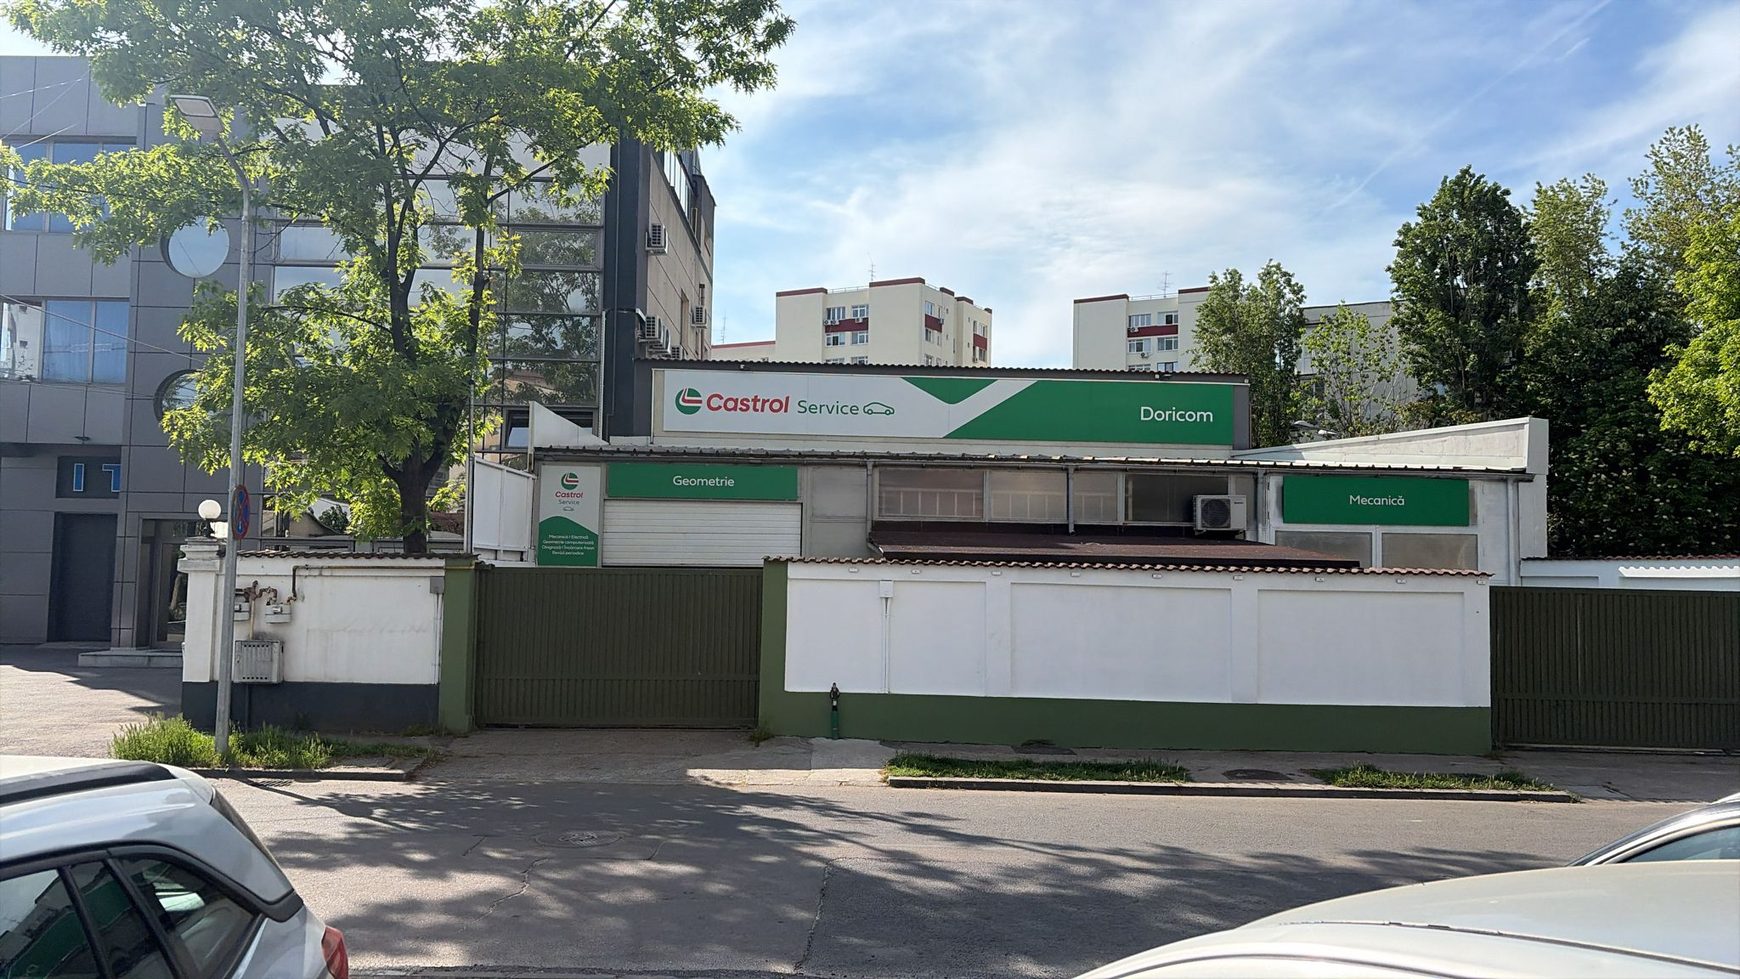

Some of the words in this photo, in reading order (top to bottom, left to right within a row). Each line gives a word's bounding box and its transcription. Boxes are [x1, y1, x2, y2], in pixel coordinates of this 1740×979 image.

[706, 393, 790, 414] Castrol
[797, 400, 860, 415] Service
[1140, 406, 1213, 423] Doricom
[672, 475, 735, 487] Geometrie
[1349, 494, 1405, 506] Mecanică
